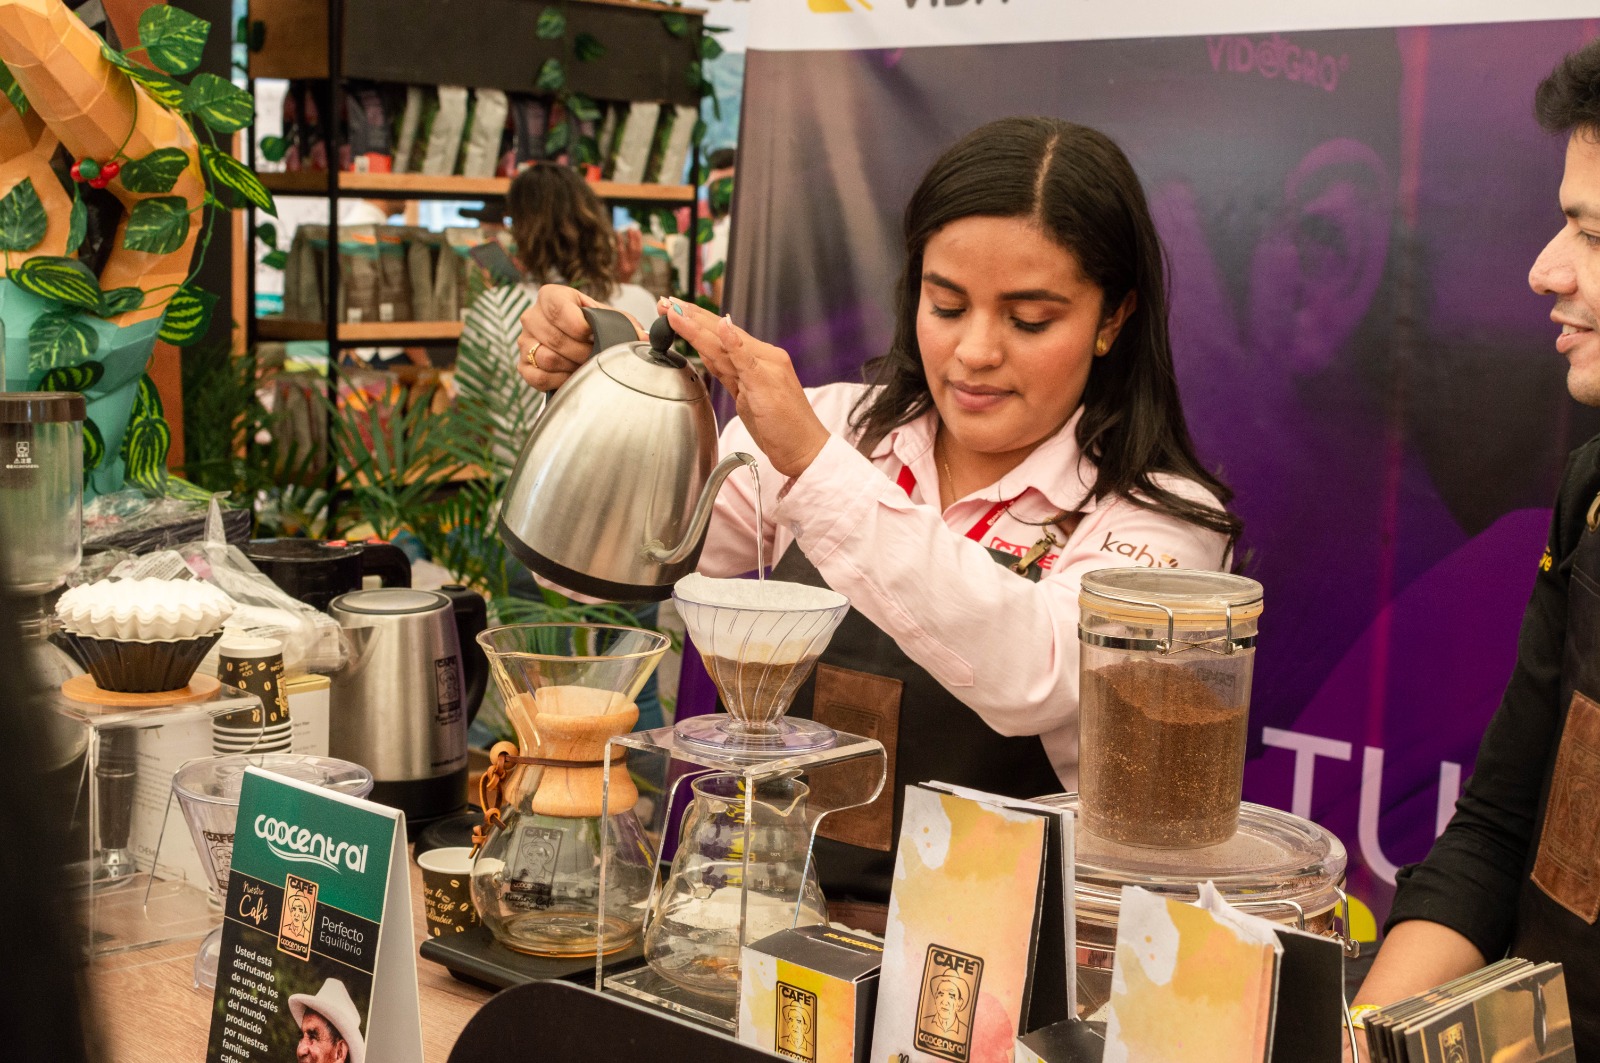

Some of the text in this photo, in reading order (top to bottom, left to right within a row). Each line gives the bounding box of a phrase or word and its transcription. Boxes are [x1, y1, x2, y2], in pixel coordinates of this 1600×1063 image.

[254, 814, 369, 874] coocentral
[289, 878, 314, 895] CAFÉ
[239, 894, 268, 925] Café
[321, 916, 364, 943] Perfecto
[320, 931, 362, 956] Equilibrio
[235, 944, 273, 968] Usted está
[933, 952, 975, 976] CAFÉ
[233, 959, 275, 983] disfrutando
[231, 972, 279, 999] de uno de los
[781, 986, 811, 1007] CAFÉ
[229, 986, 279, 1013] mejores cafés
[225, 1013, 262, 1035] producido
[227, 999, 268, 1025] del mundo,
[222, 1038, 250, 1059] familias
[223, 1027, 269, 1052] por nuestras
[918, 1032, 966, 1056] coocentral
